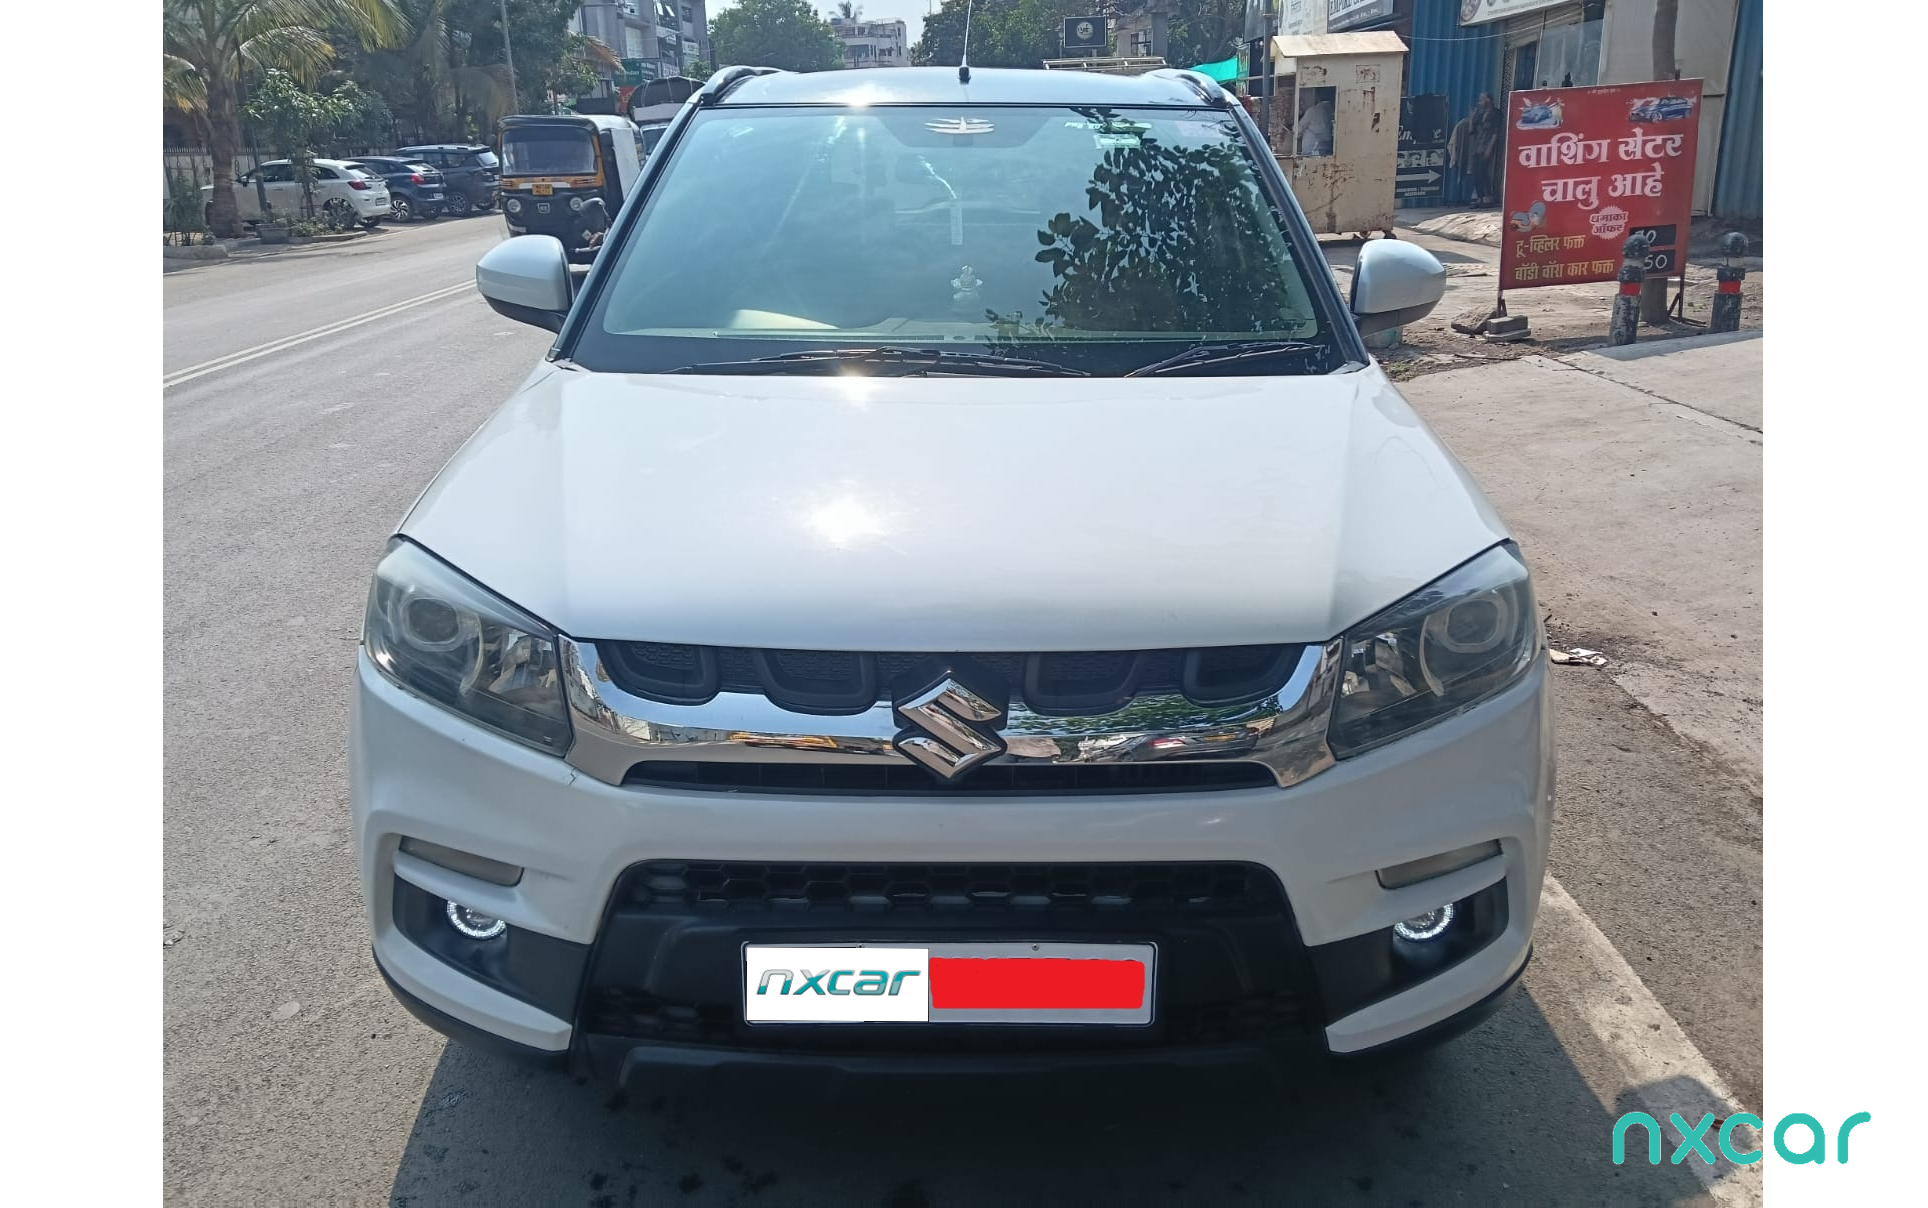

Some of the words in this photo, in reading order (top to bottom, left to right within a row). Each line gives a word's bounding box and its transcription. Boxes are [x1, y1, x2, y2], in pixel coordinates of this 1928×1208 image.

[1518, 132, 1611, 168] वाशिंग
[1541, 176, 1601, 210] चालु
[1608, 162, 1665, 198] आहे
[1591, 213, 1627, 223] धमाका
[1563, 235, 1586, 250] फक्त
[1515, 261, 1539, 281] बॉडी
[1567, 261, 1589, 277] कार
[1591, 259, 1615, 274] फक्त
